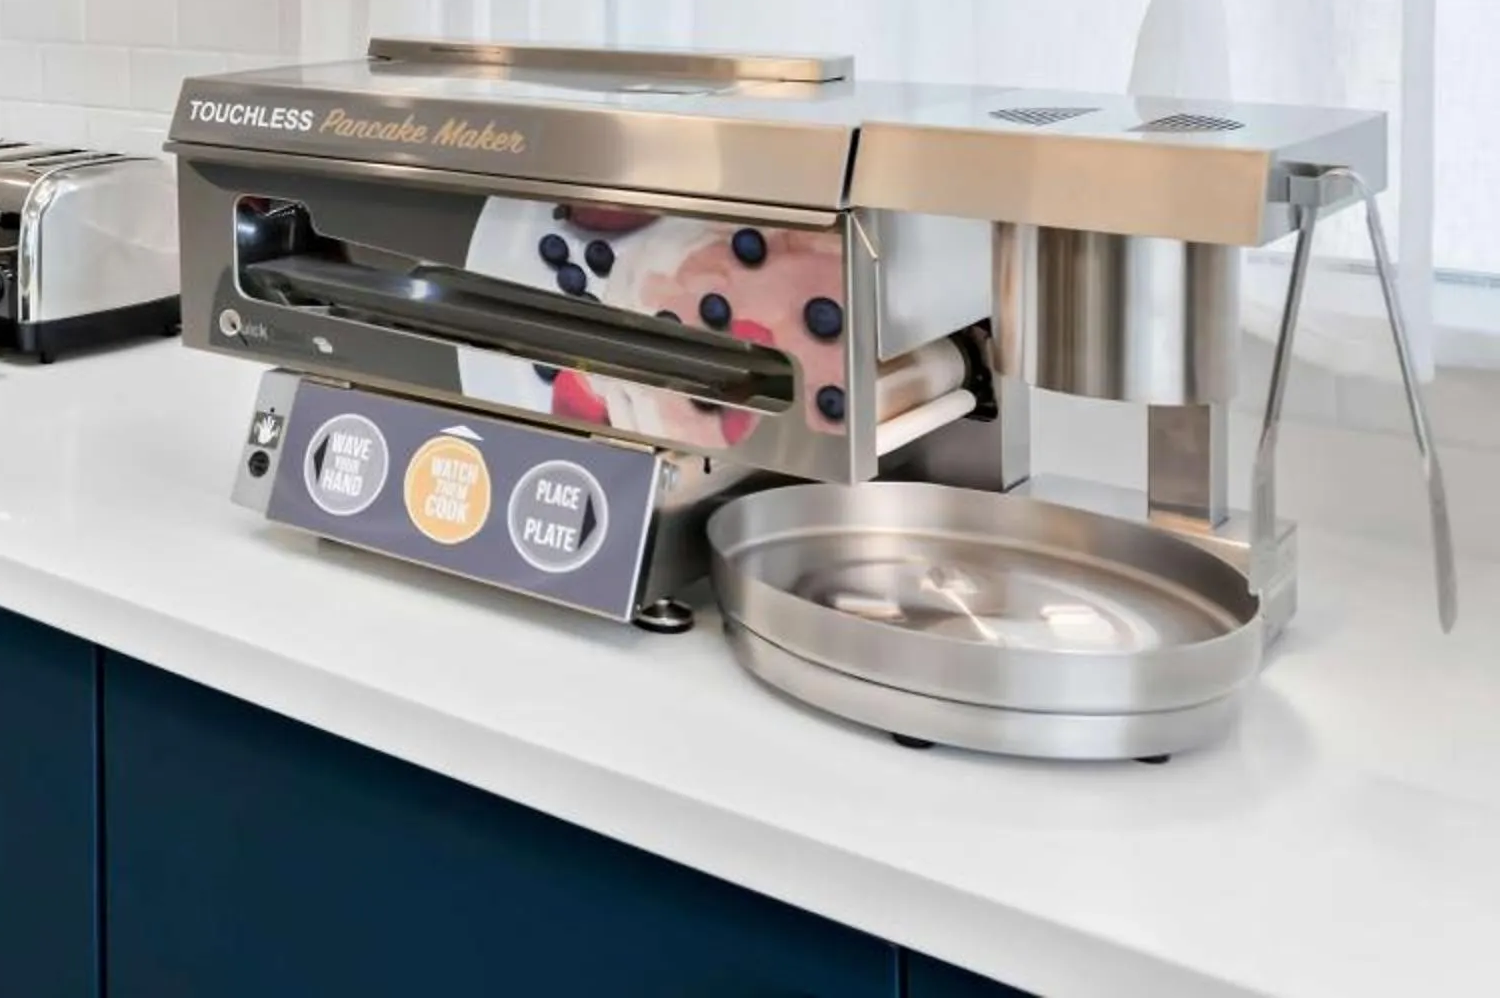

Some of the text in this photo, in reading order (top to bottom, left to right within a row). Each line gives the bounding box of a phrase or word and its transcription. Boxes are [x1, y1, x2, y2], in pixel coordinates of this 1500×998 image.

[190, 100, 525, 153] TOUCHLESS Pancake Maker
[332, 431, 372, 460] WAVE
[322, 468, 363, 497] HAND
[431, 455, 479, 486] WATCH
[424, 493, 469, 525] COOK
[536, 479, 581, 510] PLACE
[523, 518, 577, 552] PLATE
